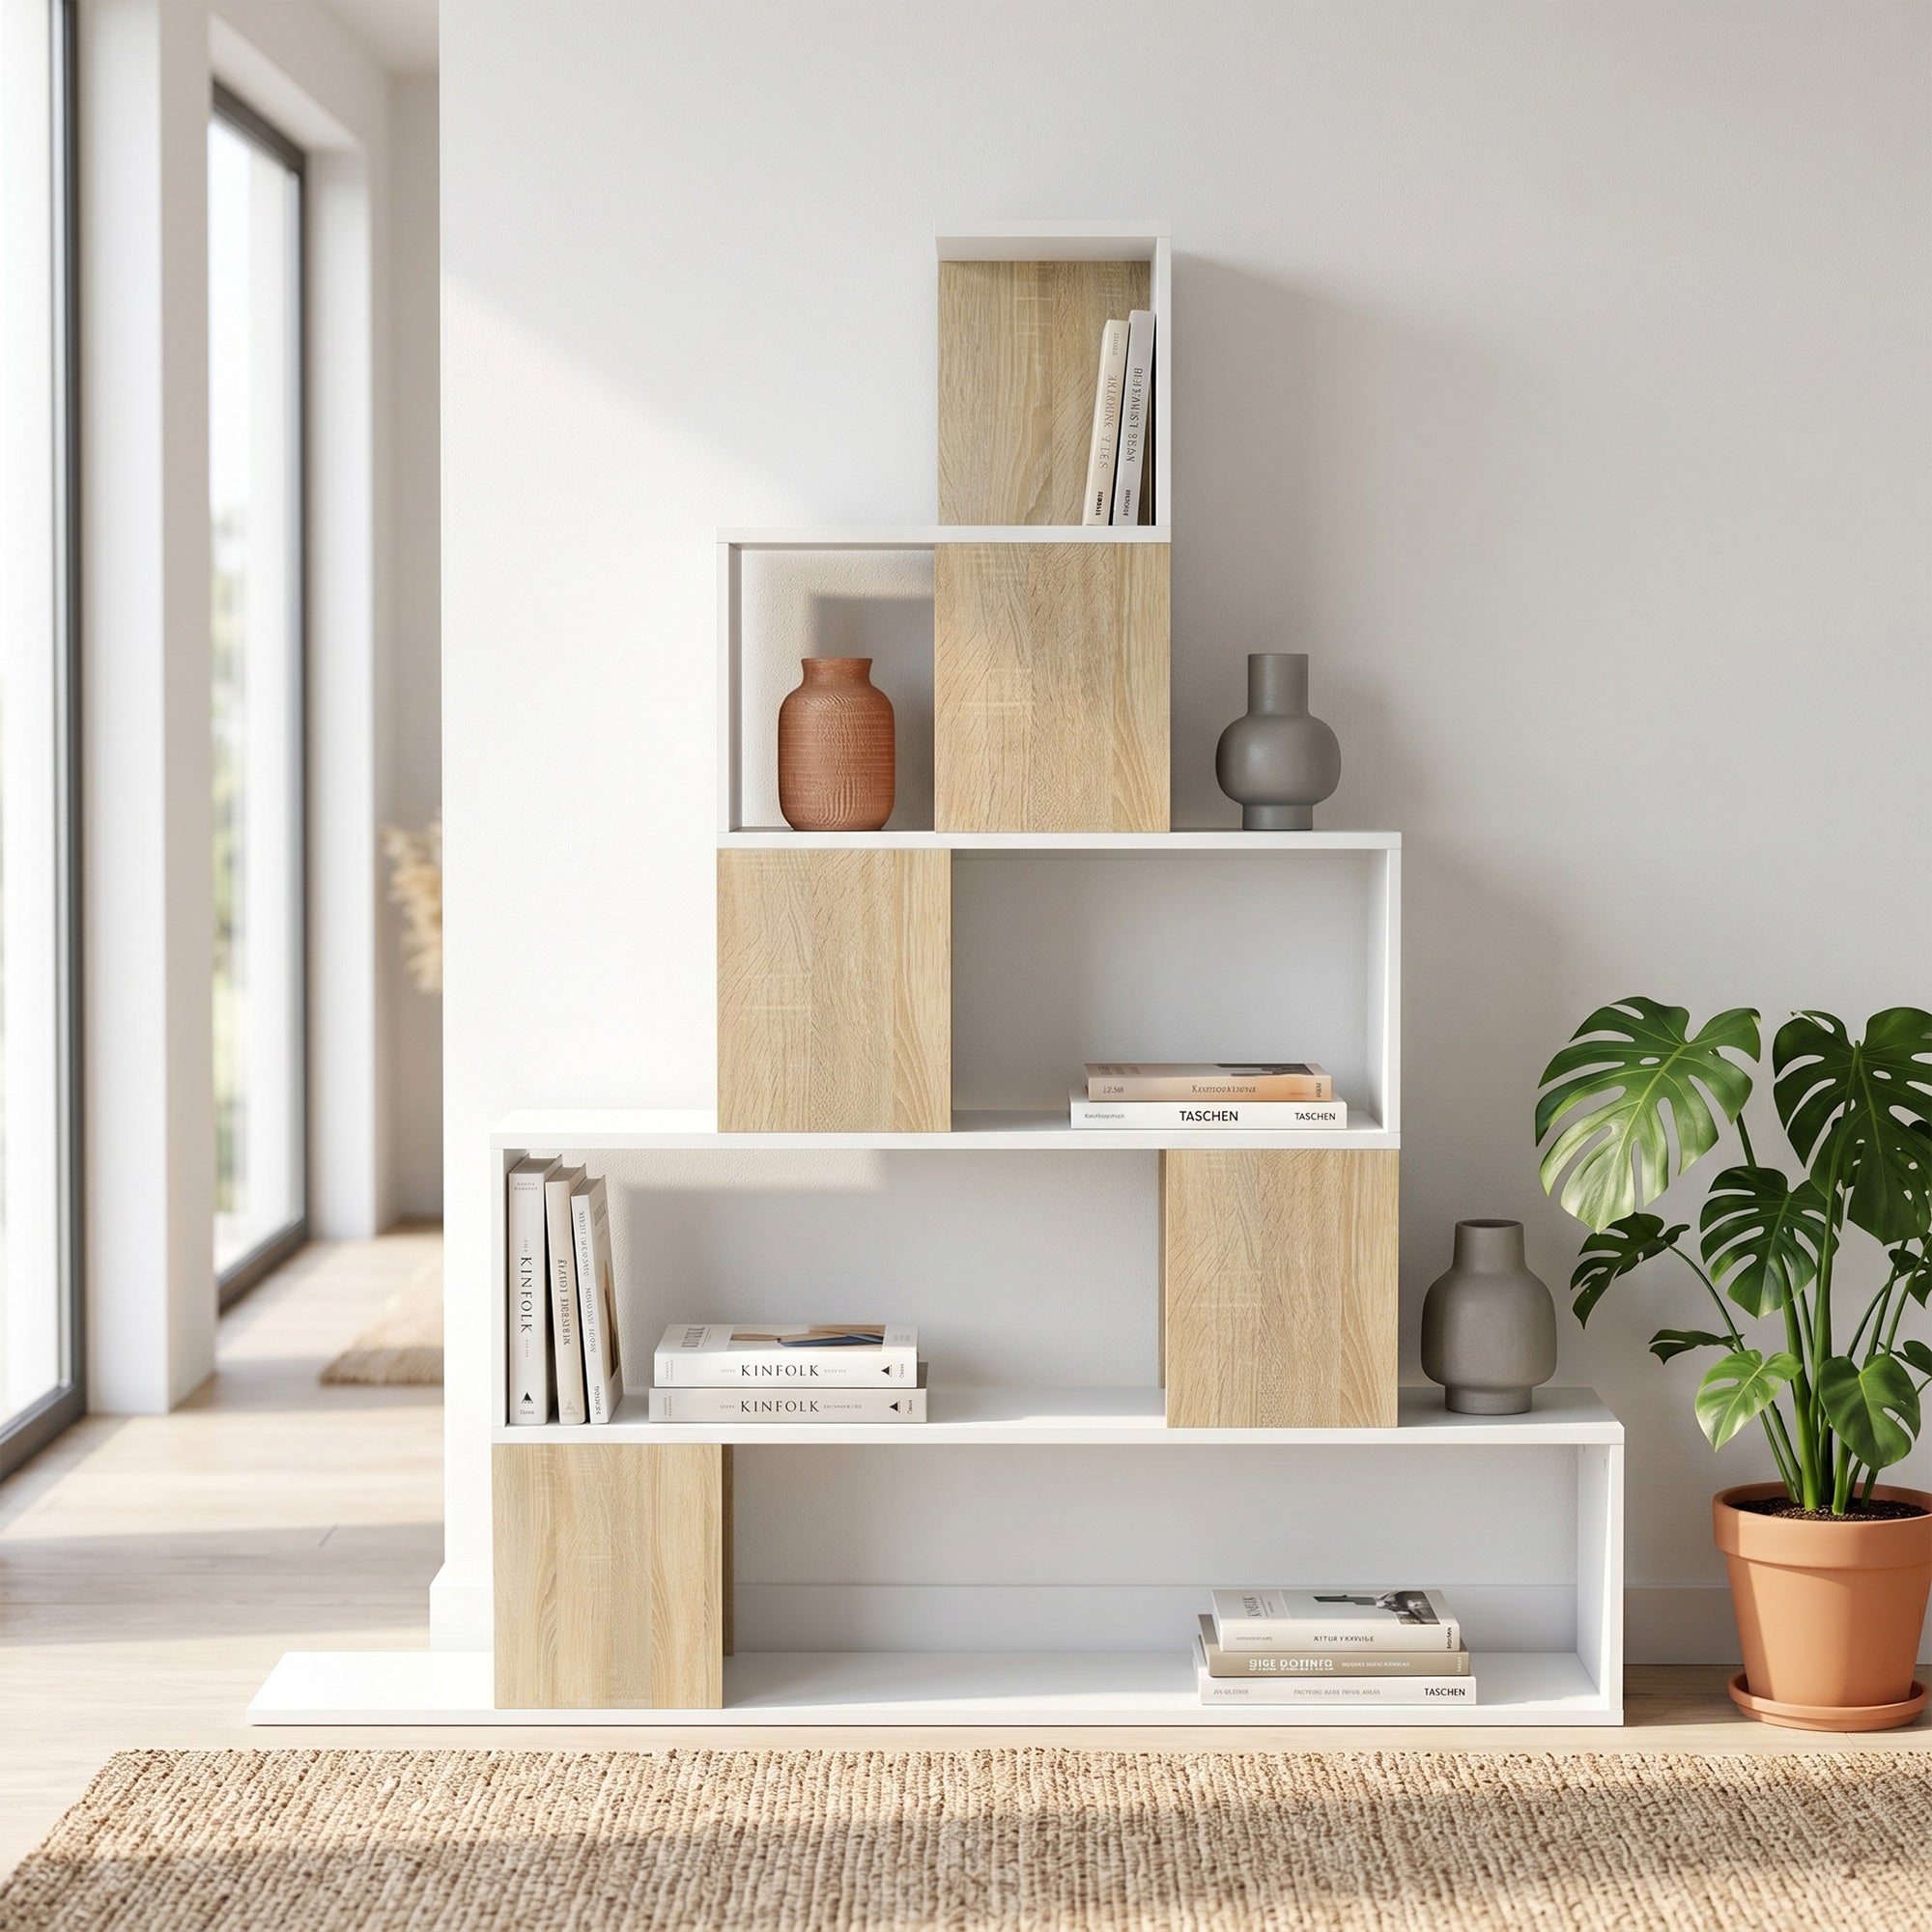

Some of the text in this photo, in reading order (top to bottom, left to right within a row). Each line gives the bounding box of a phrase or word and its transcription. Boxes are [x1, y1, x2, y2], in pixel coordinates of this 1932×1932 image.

[1179, 1110, 1238, 1122] TASCHEN
[1294, 1112, 1336, 1121] TASCHEN
[521, 1256, 533, 1334] KINFOLK
[741, 1364, 820, 1377] KINFOLK
[741, 1400, 820, 1412] KINFOLK
[1424, 1688, 1465, 1696] TASCHEN
